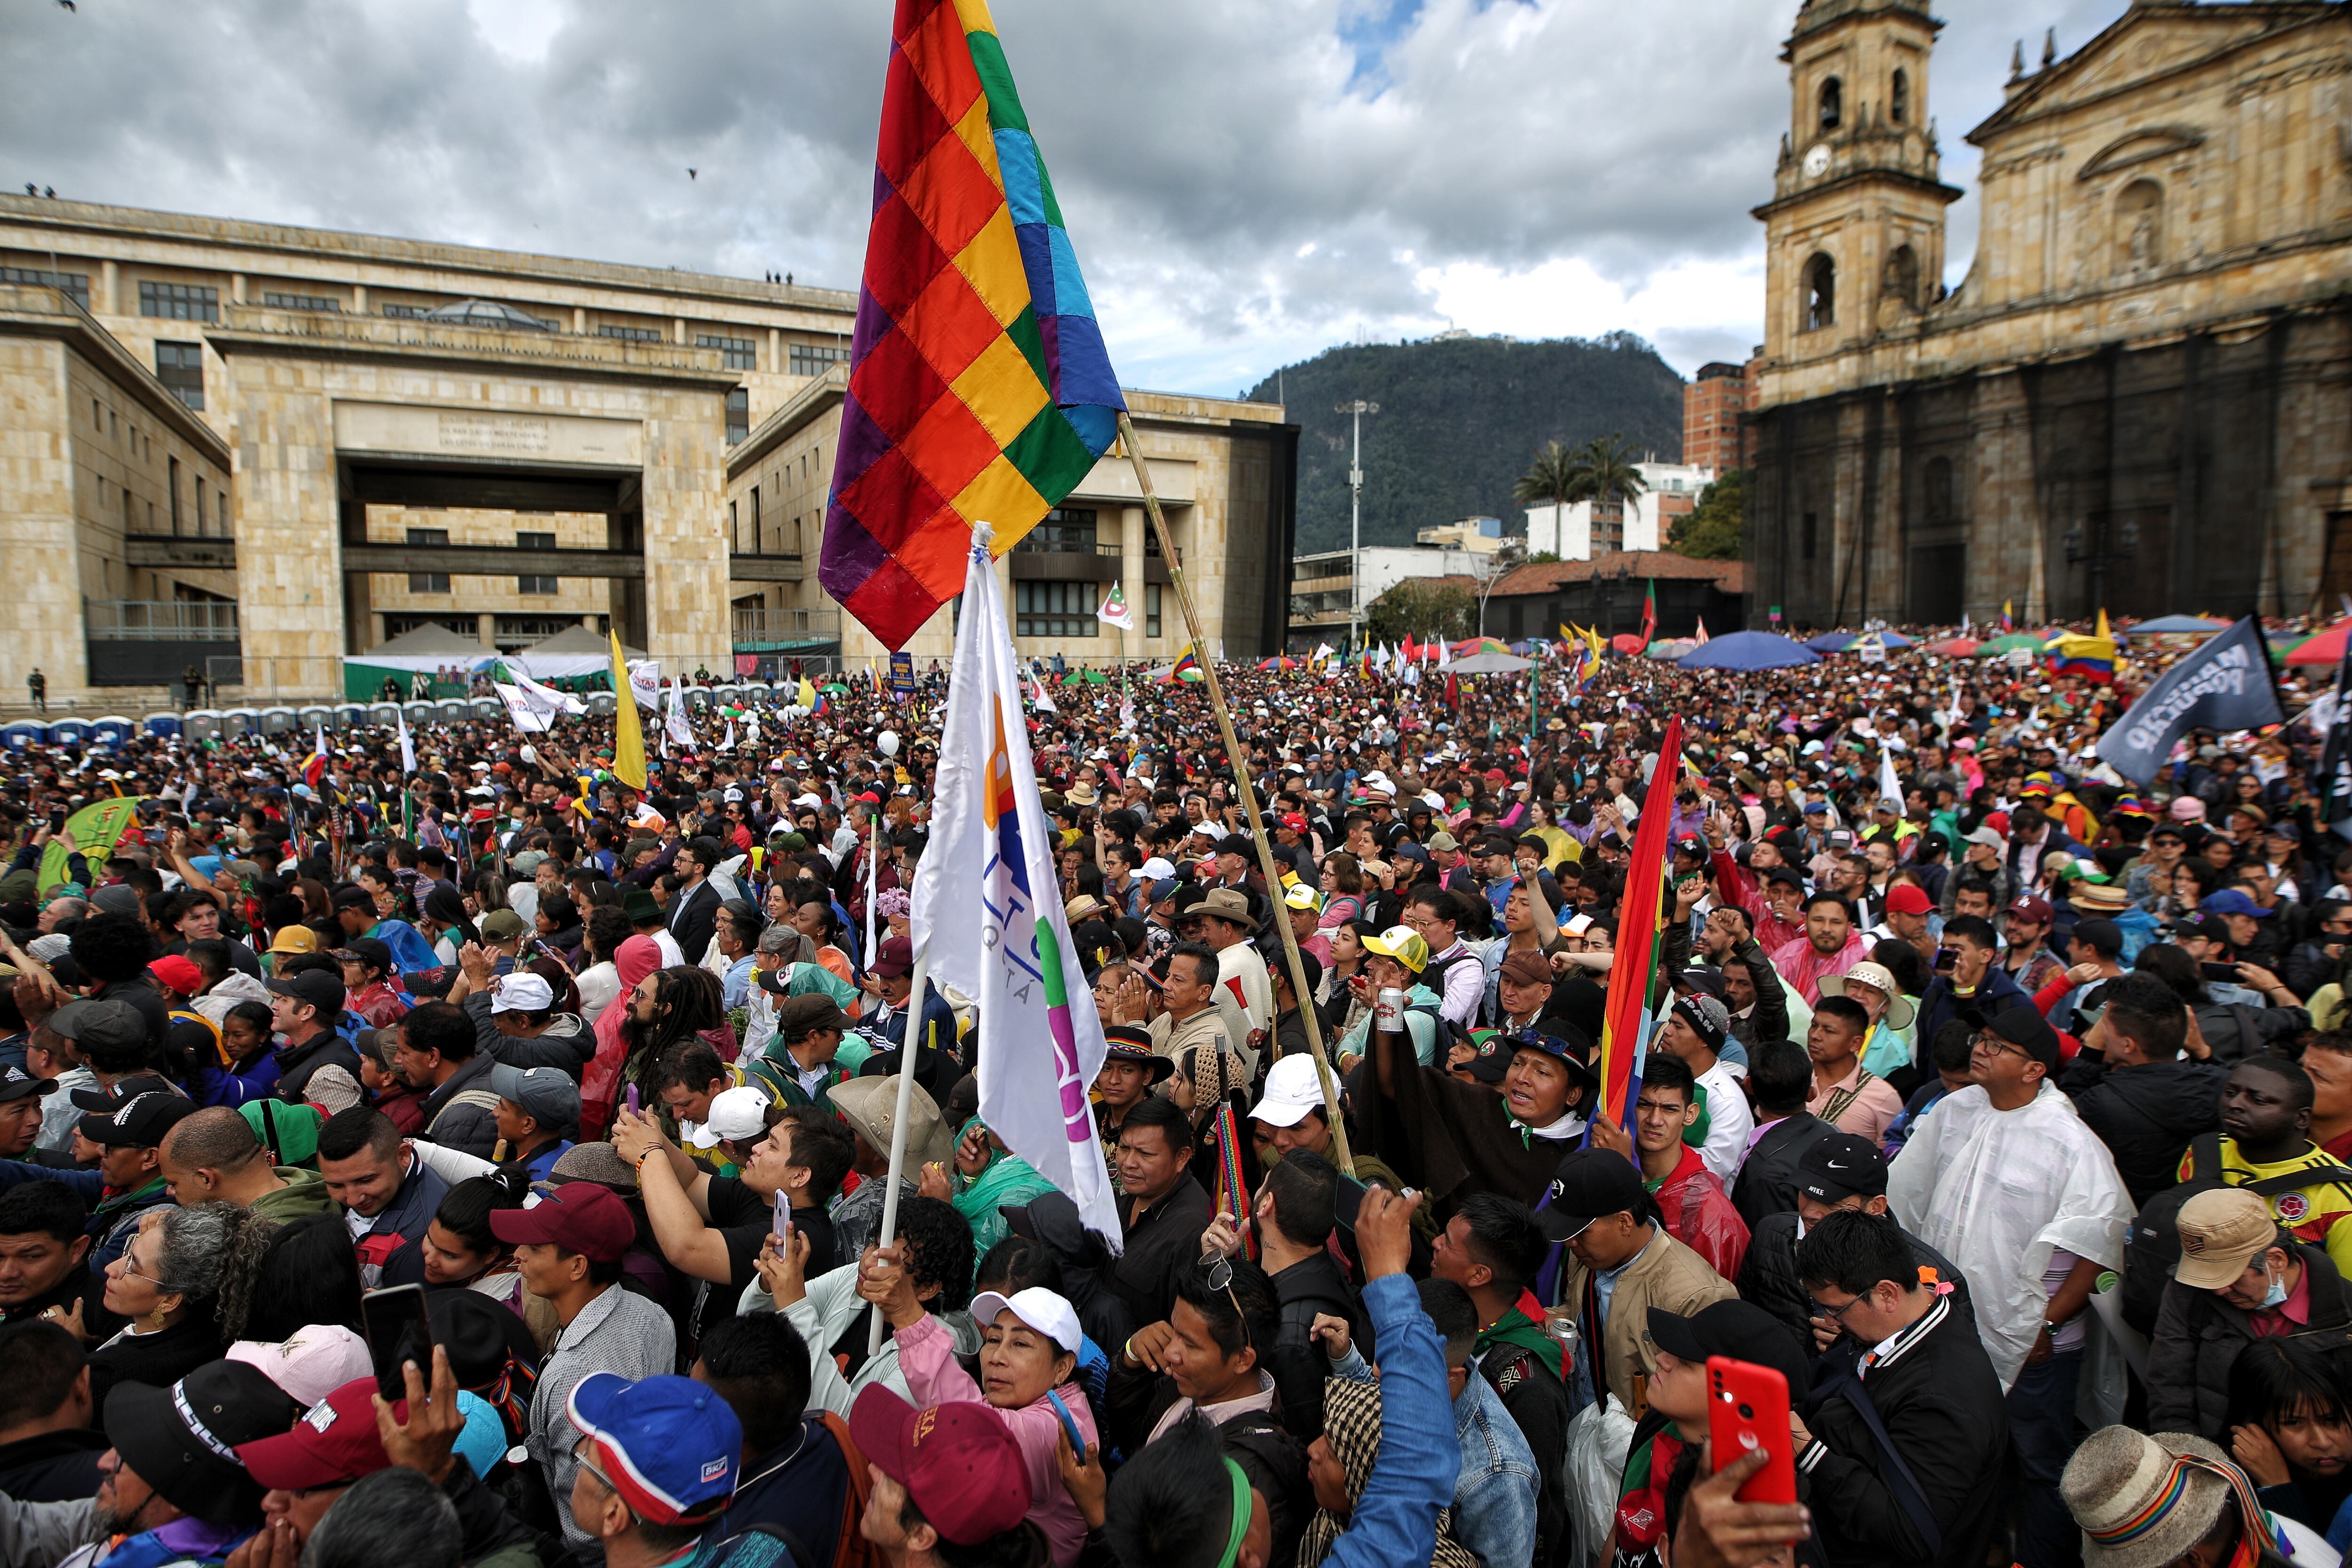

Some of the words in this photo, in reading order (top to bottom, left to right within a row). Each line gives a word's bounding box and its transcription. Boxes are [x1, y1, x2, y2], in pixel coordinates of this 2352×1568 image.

[1680, 996, 1715, 1033] RDAN
[1808, 1186, 1825, 1195] NIKE
[706, 1460, 725, 1475] SKF
